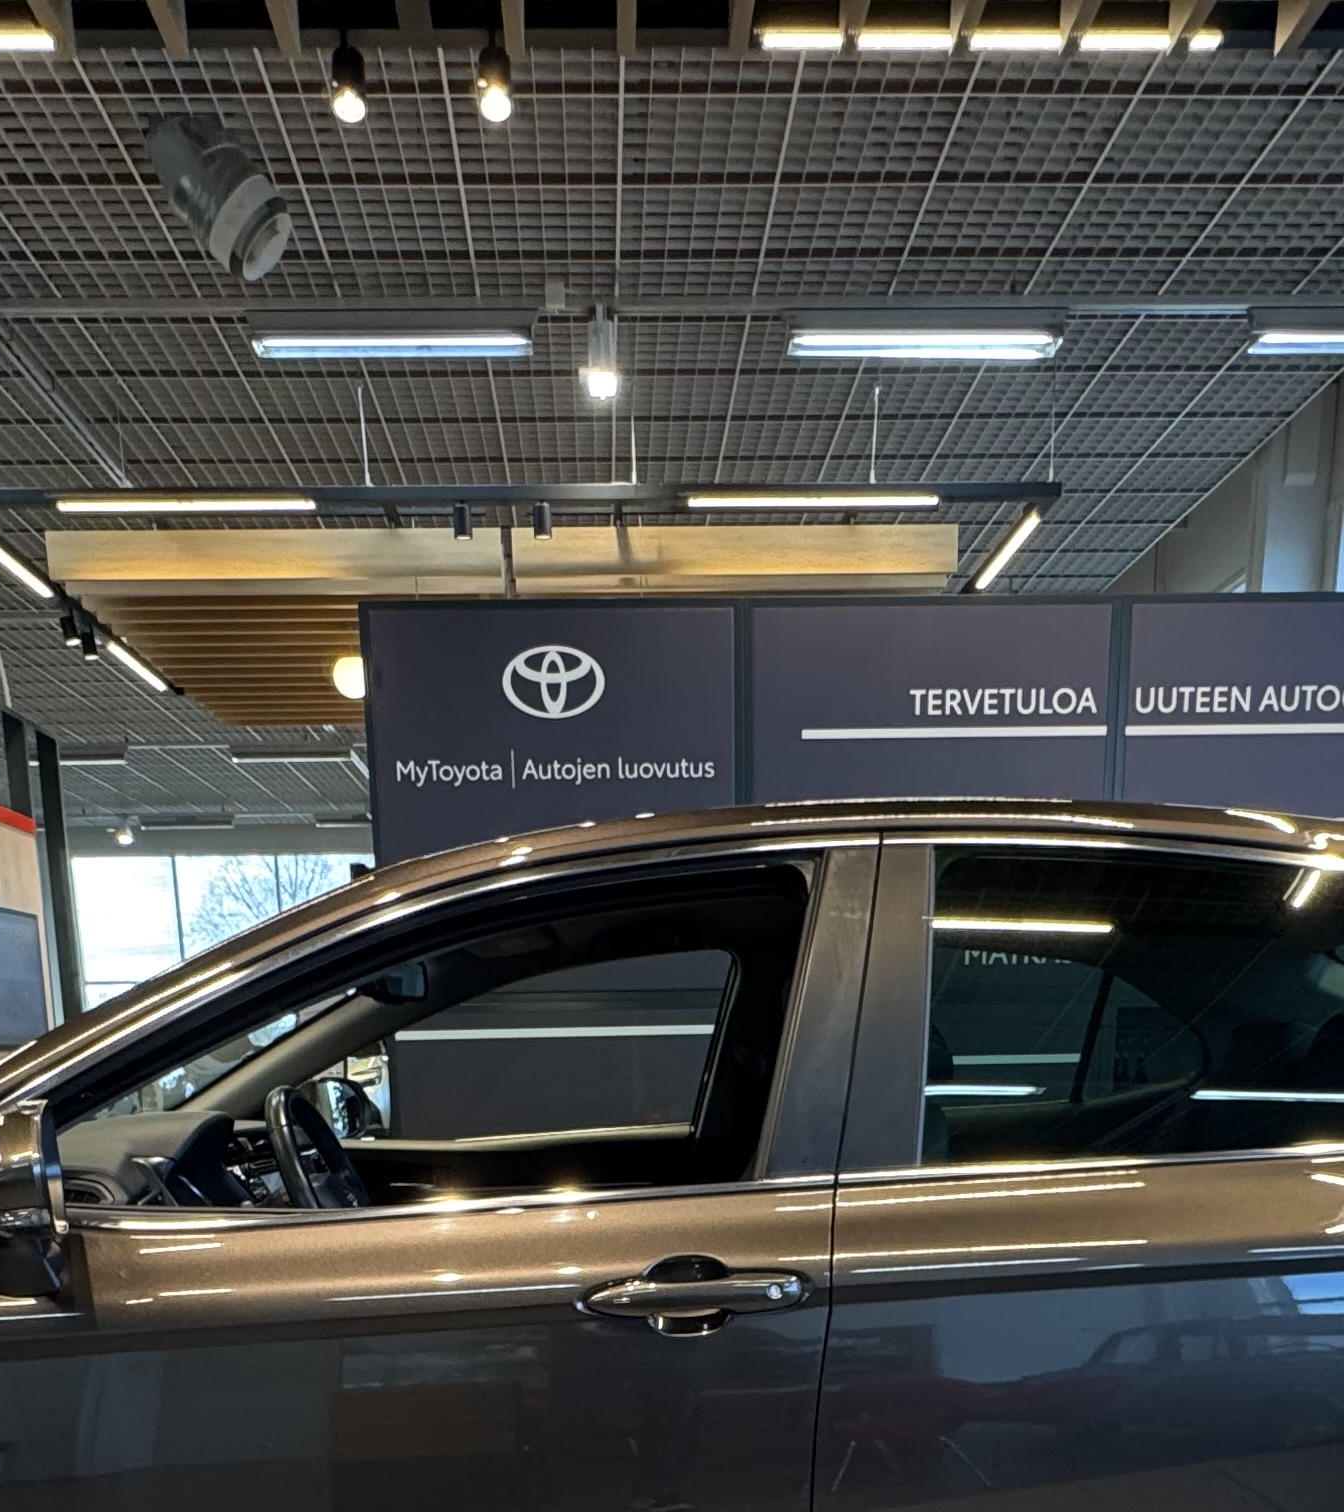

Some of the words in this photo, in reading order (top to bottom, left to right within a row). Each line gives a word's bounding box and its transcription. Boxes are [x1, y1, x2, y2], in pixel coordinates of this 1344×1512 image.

[909, 686, 1098, 716] TERVETULOA
[1135, 685, 1252, 714] UUTEEN
[396, 759, 503, 787] MyToyota
[522, 757, 611, 785] Autojen
[617, 756, 715, 779] luovutus
